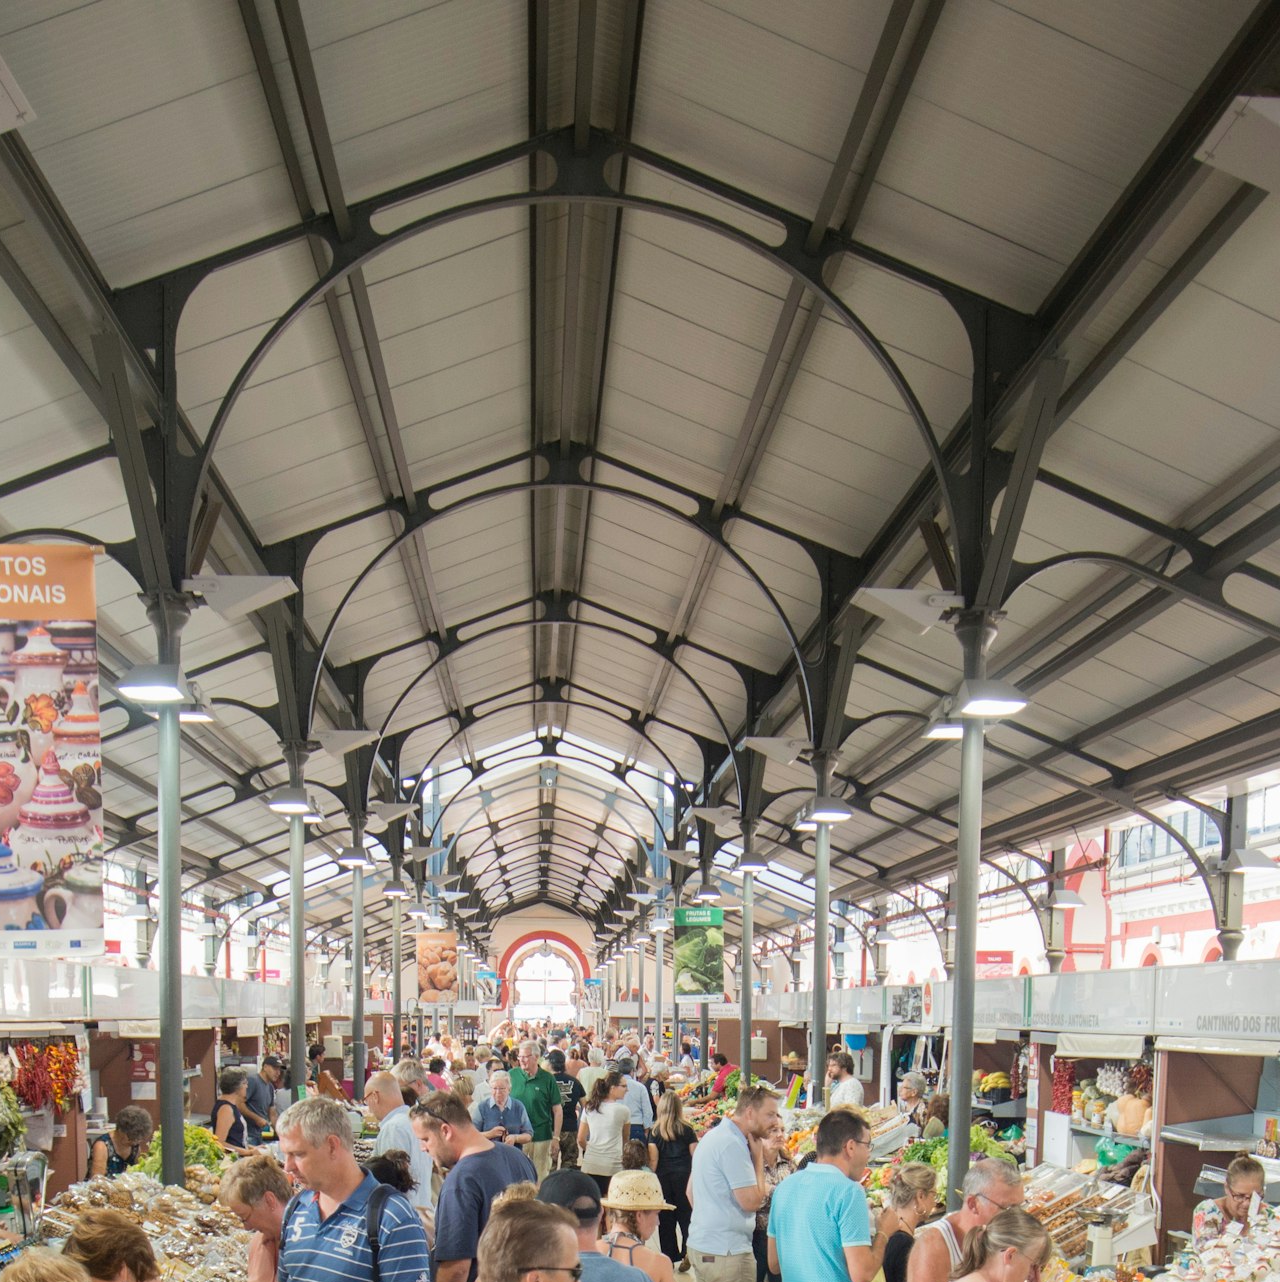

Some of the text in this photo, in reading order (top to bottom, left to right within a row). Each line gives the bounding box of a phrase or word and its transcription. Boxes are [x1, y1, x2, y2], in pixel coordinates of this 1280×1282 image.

[1068, 1015, 1100, 1028] ANTONIETA
[1195, 1015, 1241, 1032] CANTINHO
[1242, 1016, 1261, 1032] DOS
[291, 1216, 305, 1242] 5
